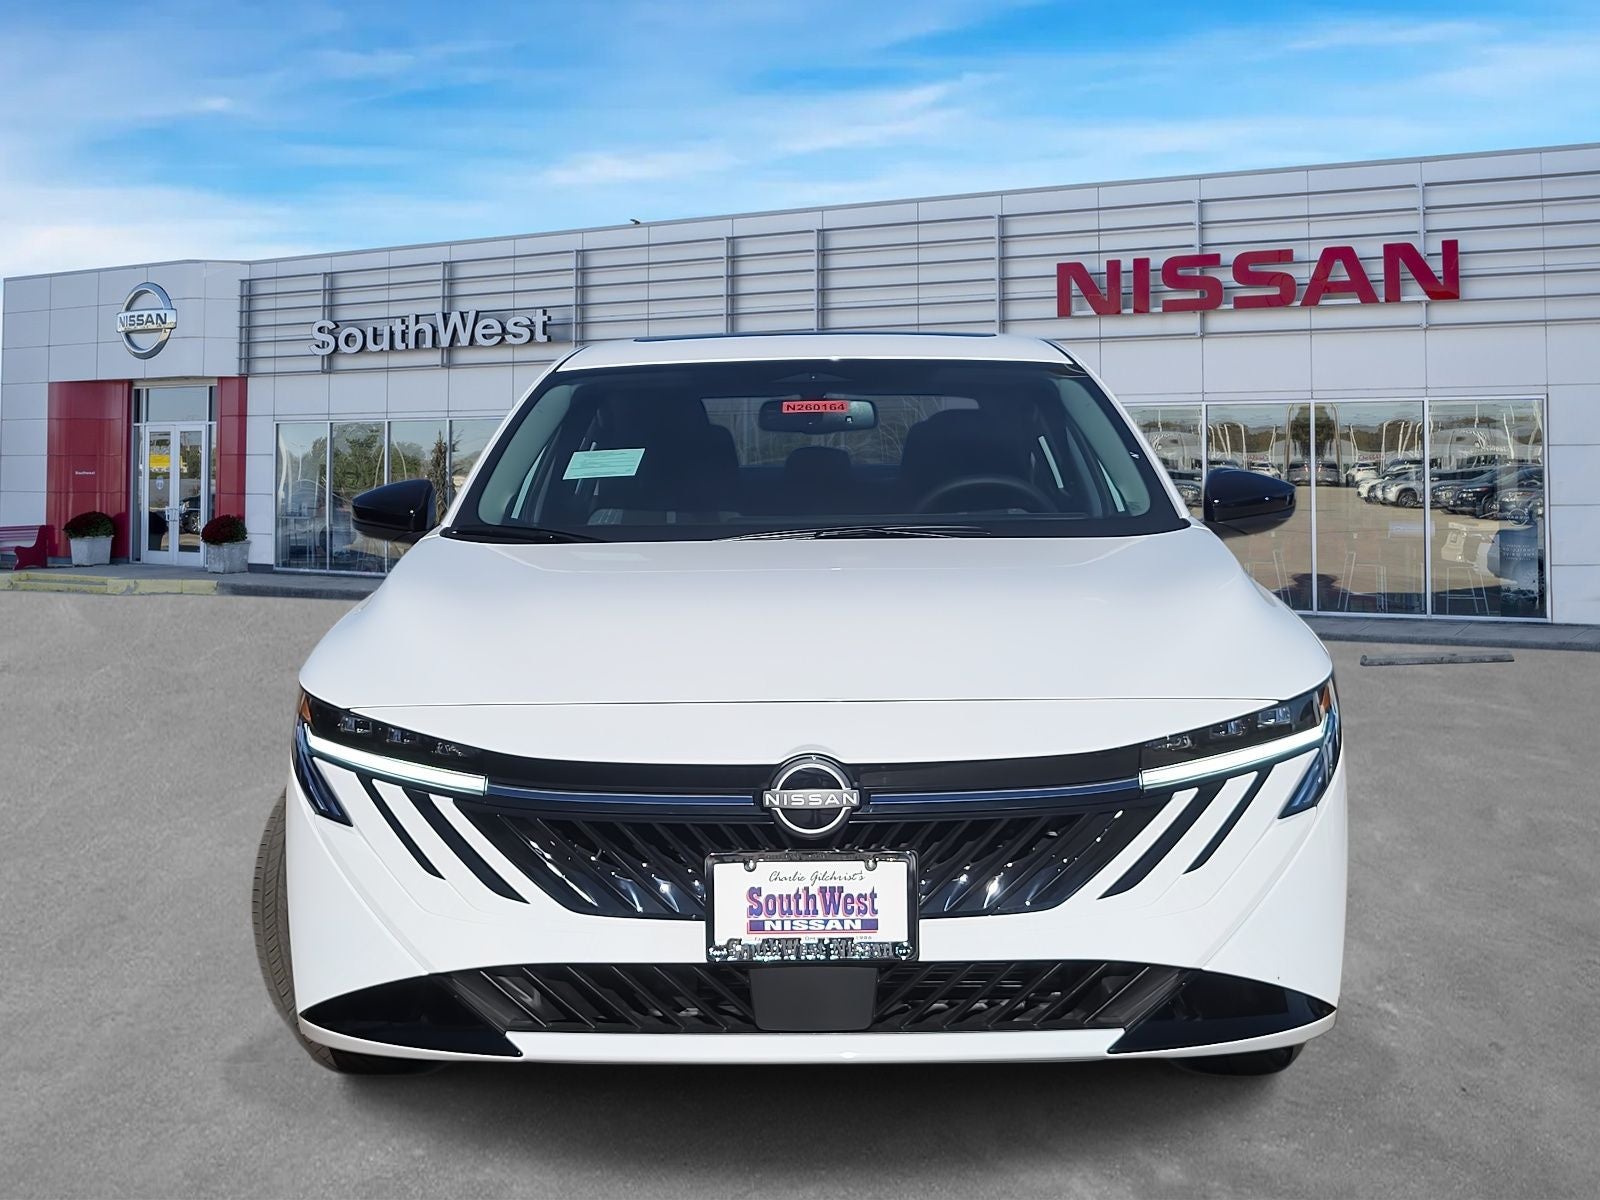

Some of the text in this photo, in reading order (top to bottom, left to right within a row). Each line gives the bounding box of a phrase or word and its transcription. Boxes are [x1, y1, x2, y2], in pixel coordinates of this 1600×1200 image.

[1056, 239, 1461, 318] NISSAN
[119, 312, 167, 328] NISSAN
[308, 309, 552, 356] SouthWest
[786, 403, 845, 412] N260164
[765, 792, 858, 807] NISSAN
[768, 870, 867, 887] Charlie Gilchrist's
[747, 885, 879, 918] SouthWest
[763, 919, 862, 931] NISSAN
